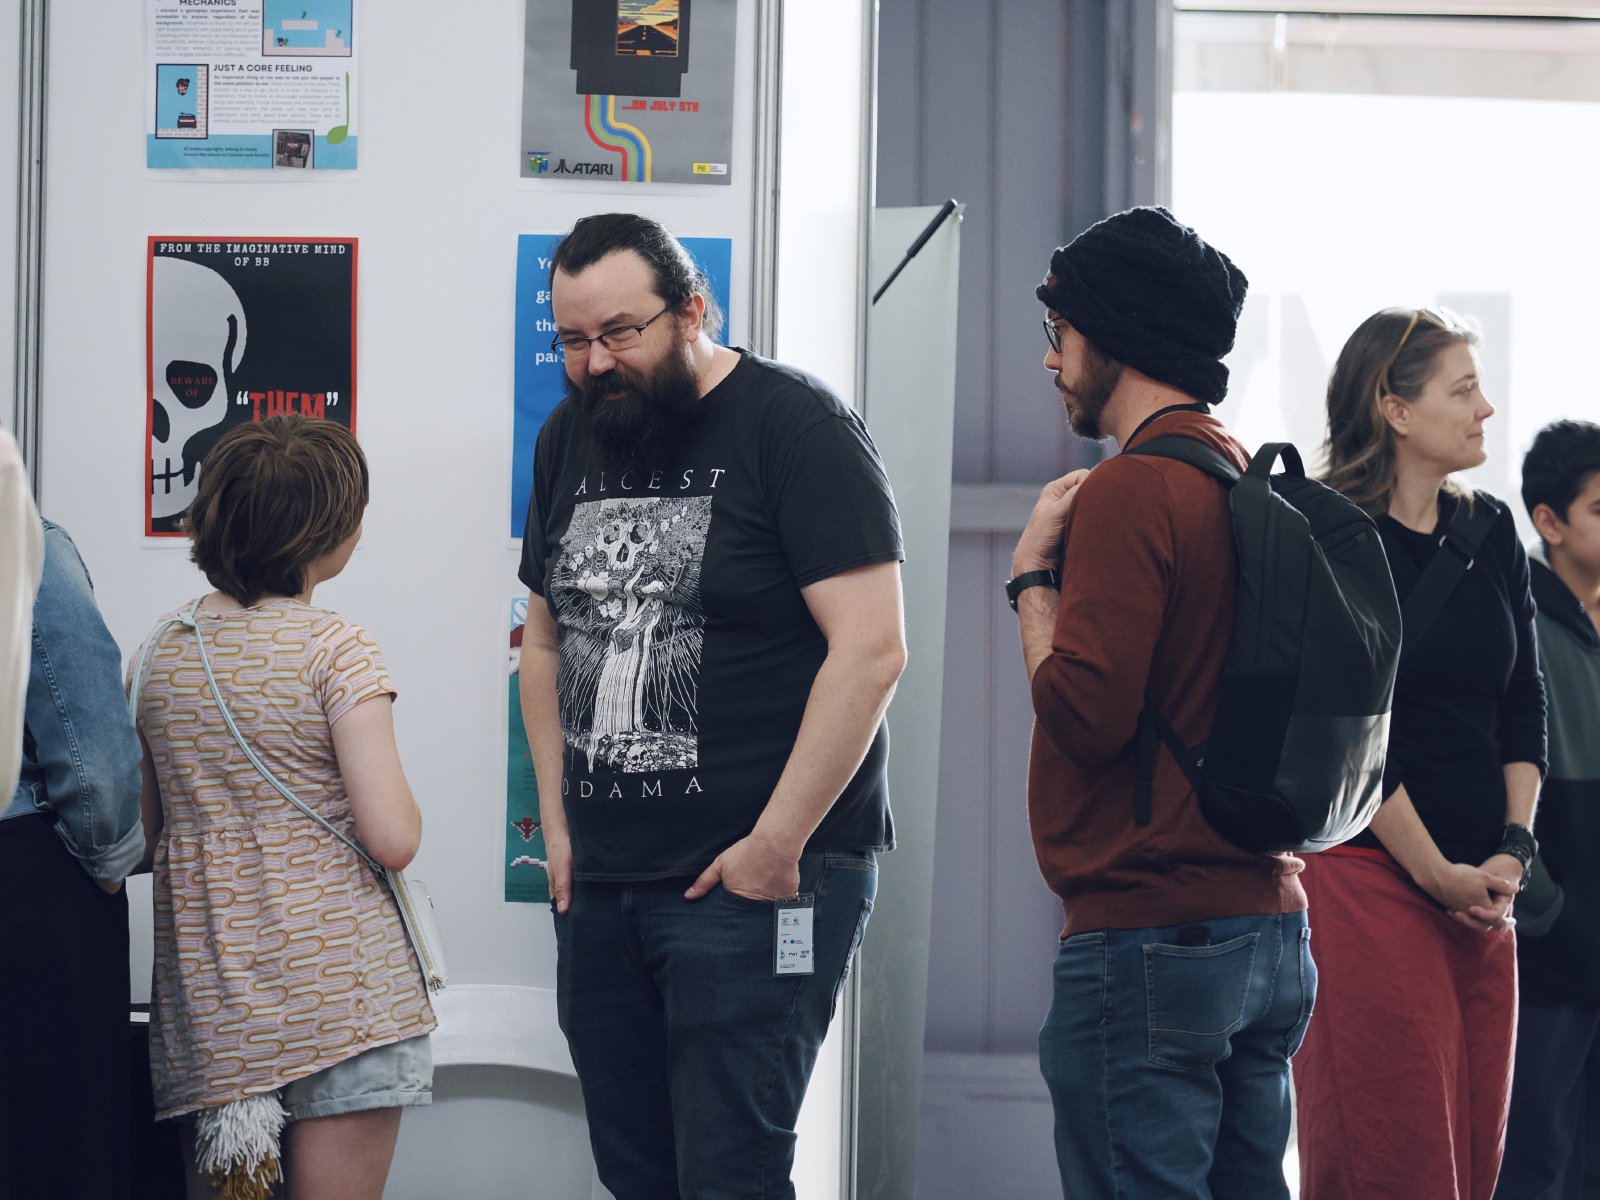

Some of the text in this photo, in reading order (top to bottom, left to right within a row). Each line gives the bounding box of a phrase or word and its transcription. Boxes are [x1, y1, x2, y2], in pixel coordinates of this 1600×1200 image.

[213, 64, 313, 73] JUST A CORE FEELING
[649, 100, 676, 112] JULY
[572, 163, 613, 176] ATARI
[160, 243, 346, 255] FROM THE IMAGINATIVE MIND
[234, 257, 270, 267] OF BB
[170, 376, 215, 385] BEWARE
[185, 389, 201, 397] OF
[574, 468, 726, 496] ALCEST
